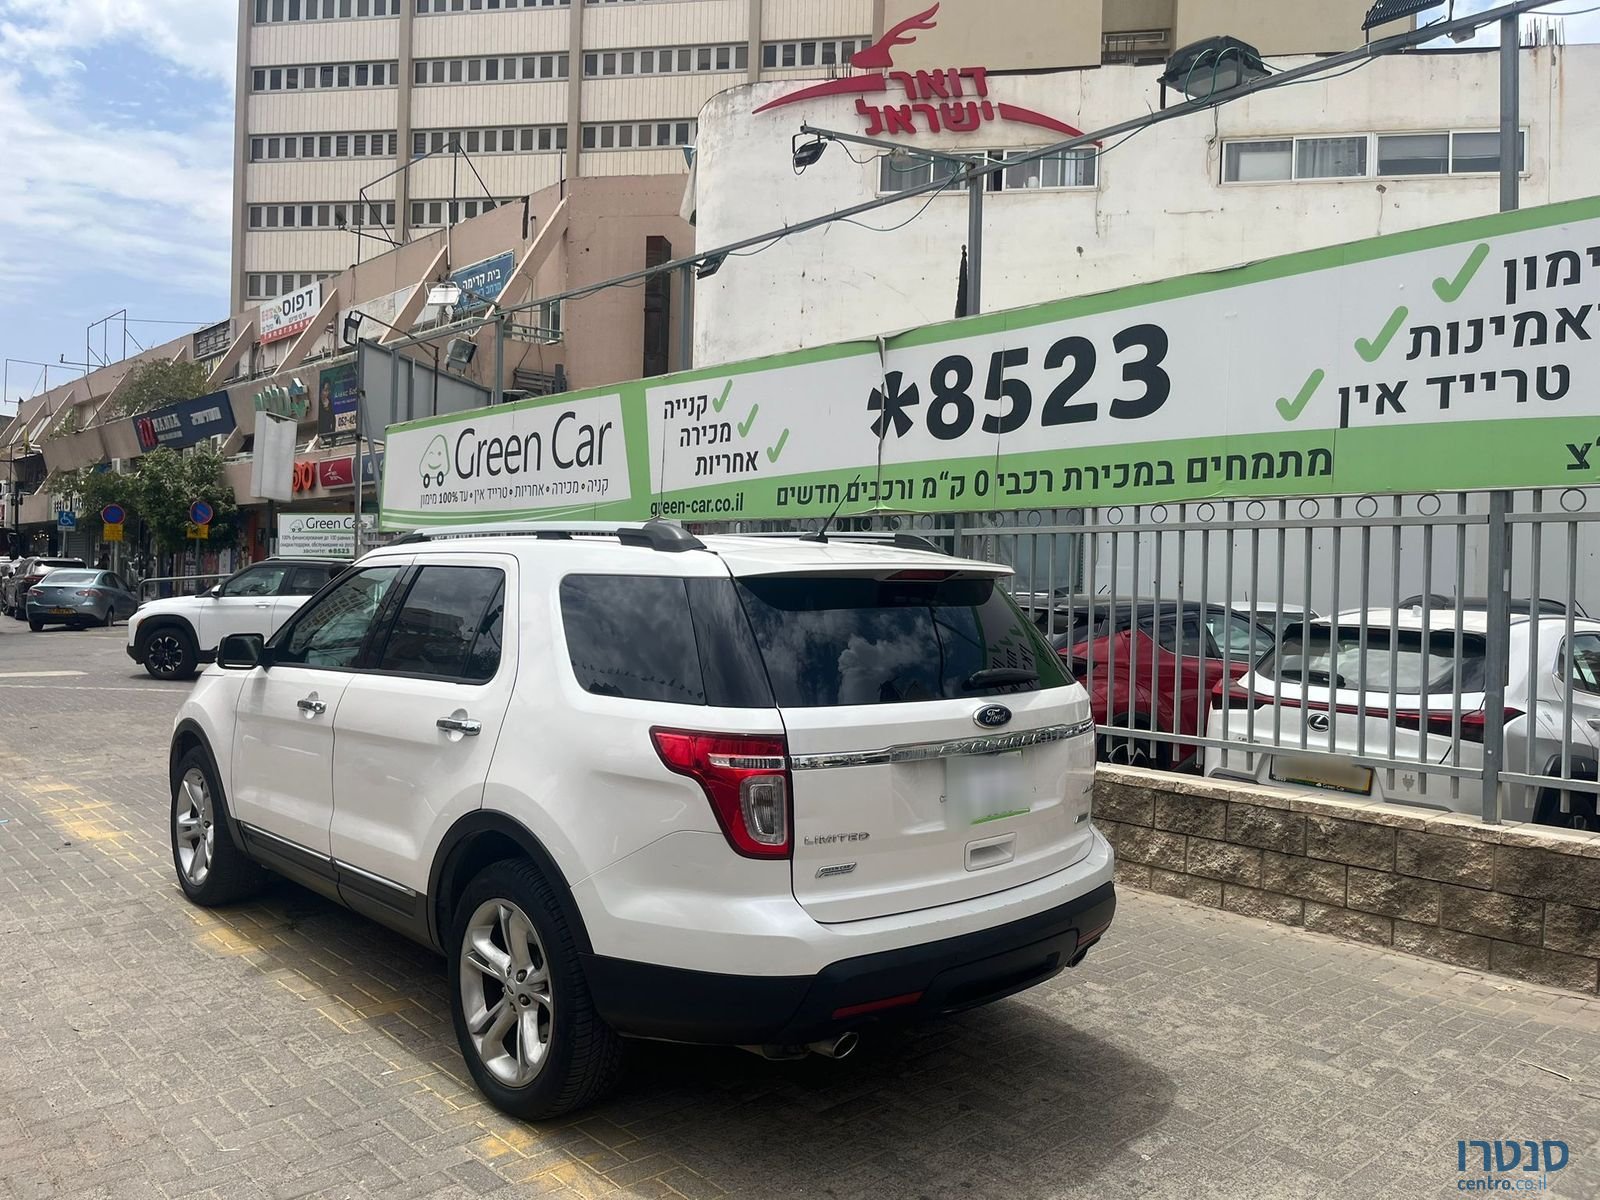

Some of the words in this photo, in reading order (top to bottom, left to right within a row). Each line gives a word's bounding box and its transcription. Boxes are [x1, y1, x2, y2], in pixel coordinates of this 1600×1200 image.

[889, 67, 987, 99] דואר
[855, 99, 994, 135] ישראל
[487, 269, 501, 282] בית
[282, 290, 313, 316] דפוס
[1406, 303, 1600, 361] אמינות
[1426, 364, 1570, 410] טרייד
[664, 395, 708, 421] קנייה
[1338, 379, 1408, 429] אין
[455, 427, 542, 479] Green
[552, 411, 612, 469] Car
[680, 422, 731, 447] מכירה
[695, 451, 759, 476] אחריות
[1062, 460, 1175, 492] במכירת
[1186, 447, 1332, 483] מתמחים
[487, 486, 508, 499] טרייד
[514, 483, 545, 498] אחריות
[551, 480, 579, 495] מכירה
[587, 478, 609, 496] קניה
[776, 483, 840, 506] חדשים
[846, 478, 914, 503] ורכבים
[997, 469, 1053, 495] רכבי
[420, 493, 438, 508] מימון
[439, 491, 458, 504] 100%
[459, 490, 469, 502] עד
[474, 488, 485, 504] אין
[650, 492, 744, 518] green-car.co.il
[306, 517, 340, 529] Green
[985, 707, 1006, 724] Ford
[804, 832, 870, 845] LIMITED
